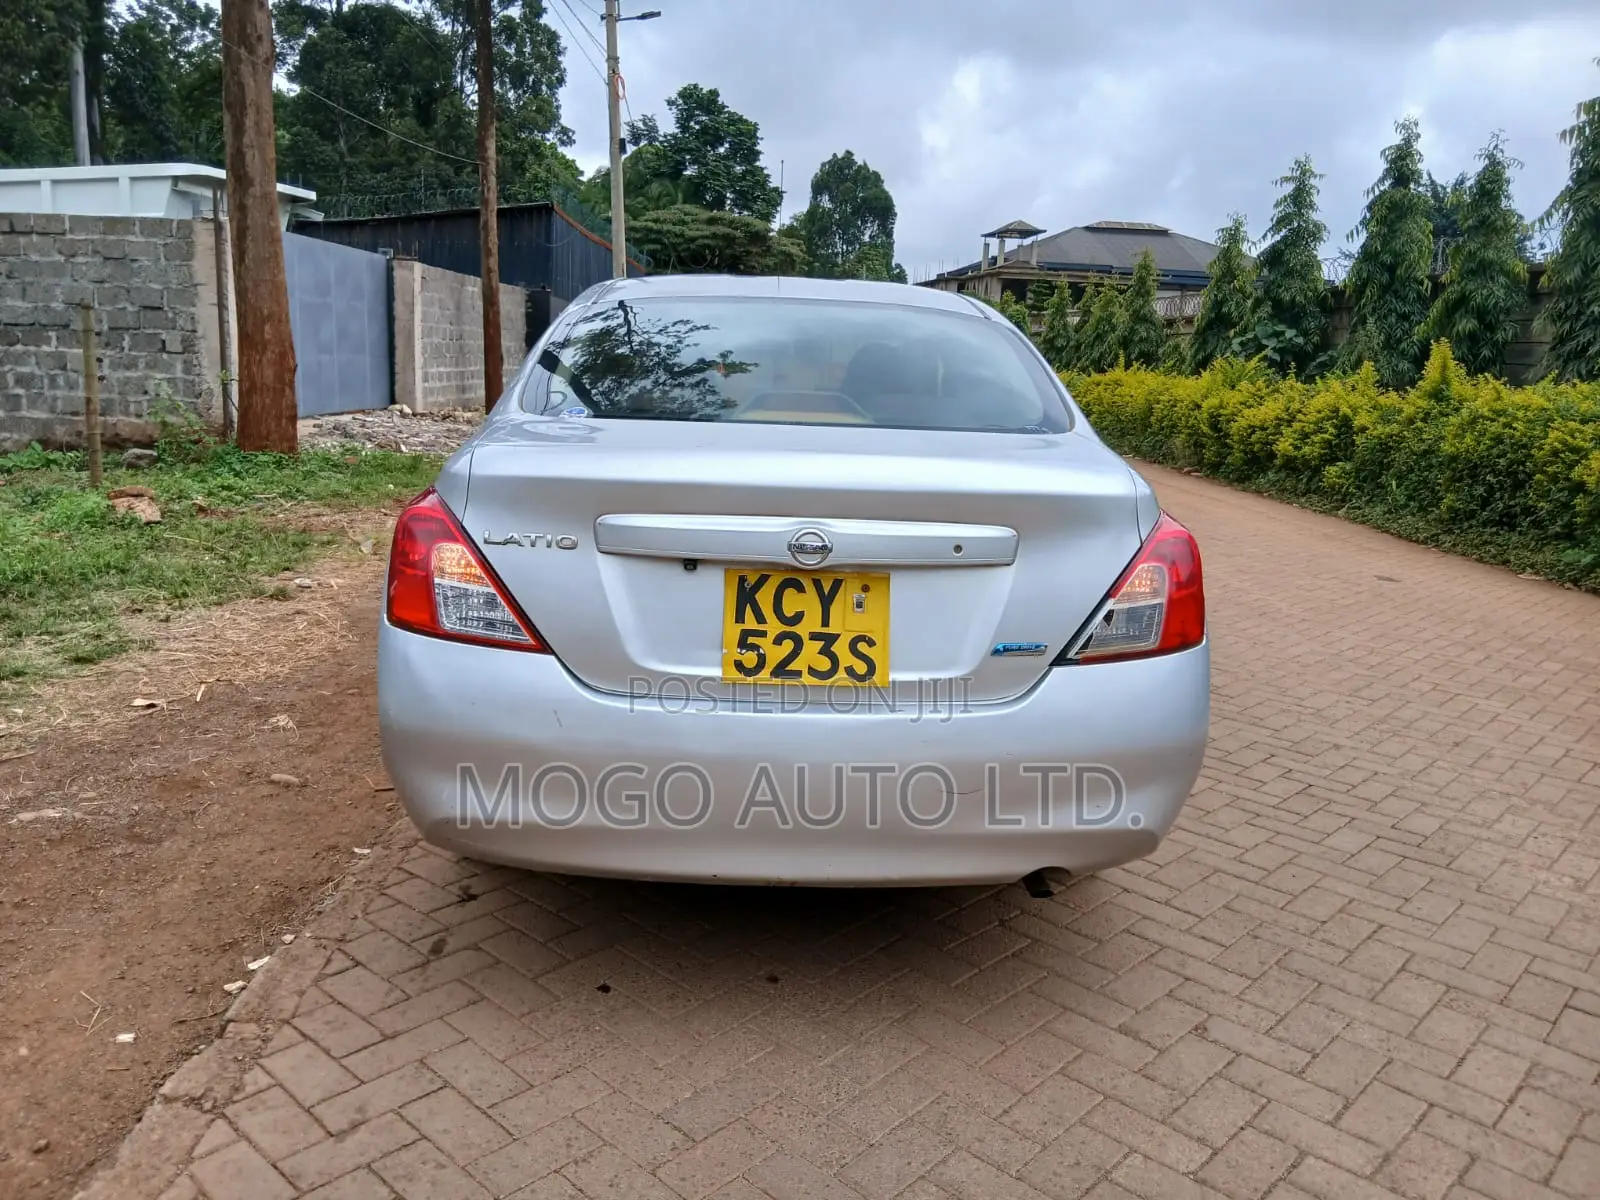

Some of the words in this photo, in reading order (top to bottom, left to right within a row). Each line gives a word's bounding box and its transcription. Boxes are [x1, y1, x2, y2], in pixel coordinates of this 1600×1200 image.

[483, 530, 579, 550] LATIO
[734, 574, 844, 628] KCY
[733, 629, 877, 683] 523S
